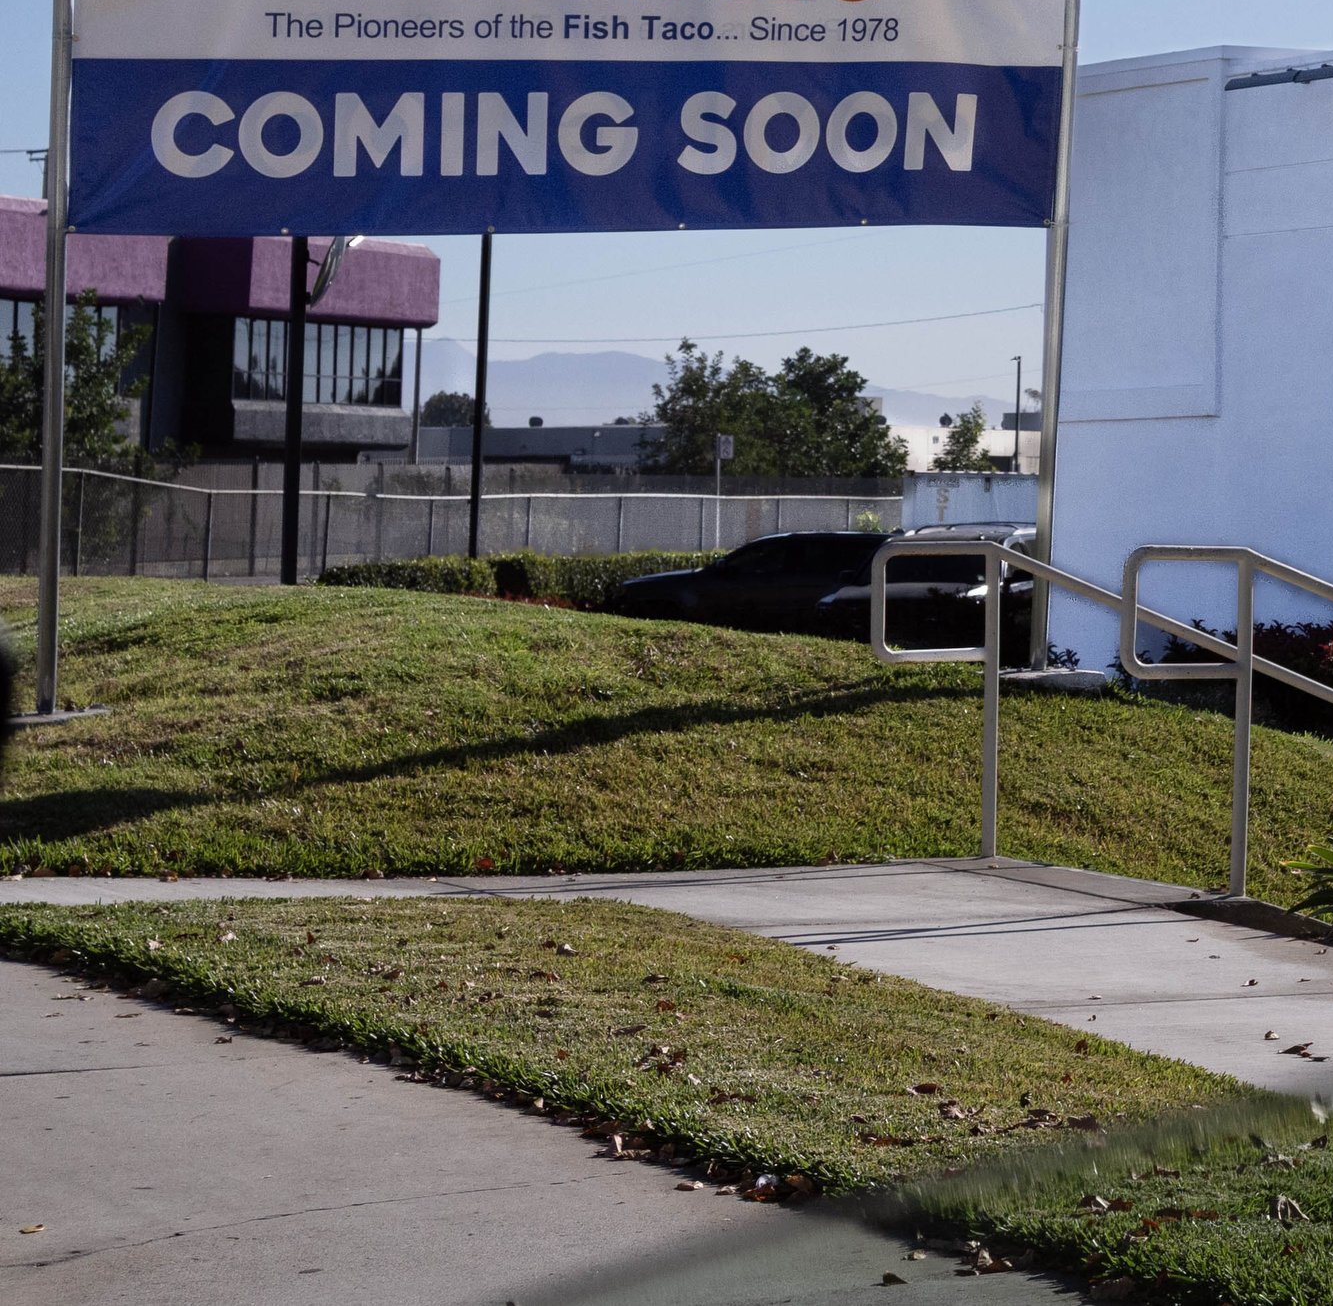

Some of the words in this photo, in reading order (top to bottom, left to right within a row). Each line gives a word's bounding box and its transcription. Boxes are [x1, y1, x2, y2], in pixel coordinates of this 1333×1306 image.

[265, 12, 324, 38] The
[334, 12, 464, 39] Pioneers
[474, 13, 504, 38] of
[511, 14, 554, 38] the
[563, 14, 630, 39] Fish
[641, 15, 739, 41] Taco...
[749, 16, 826, 41] Since
[837, 17, 899, 42] 1978
[150, 90, 639, 179] COMING
[676, 90, 978, 176] SOON
